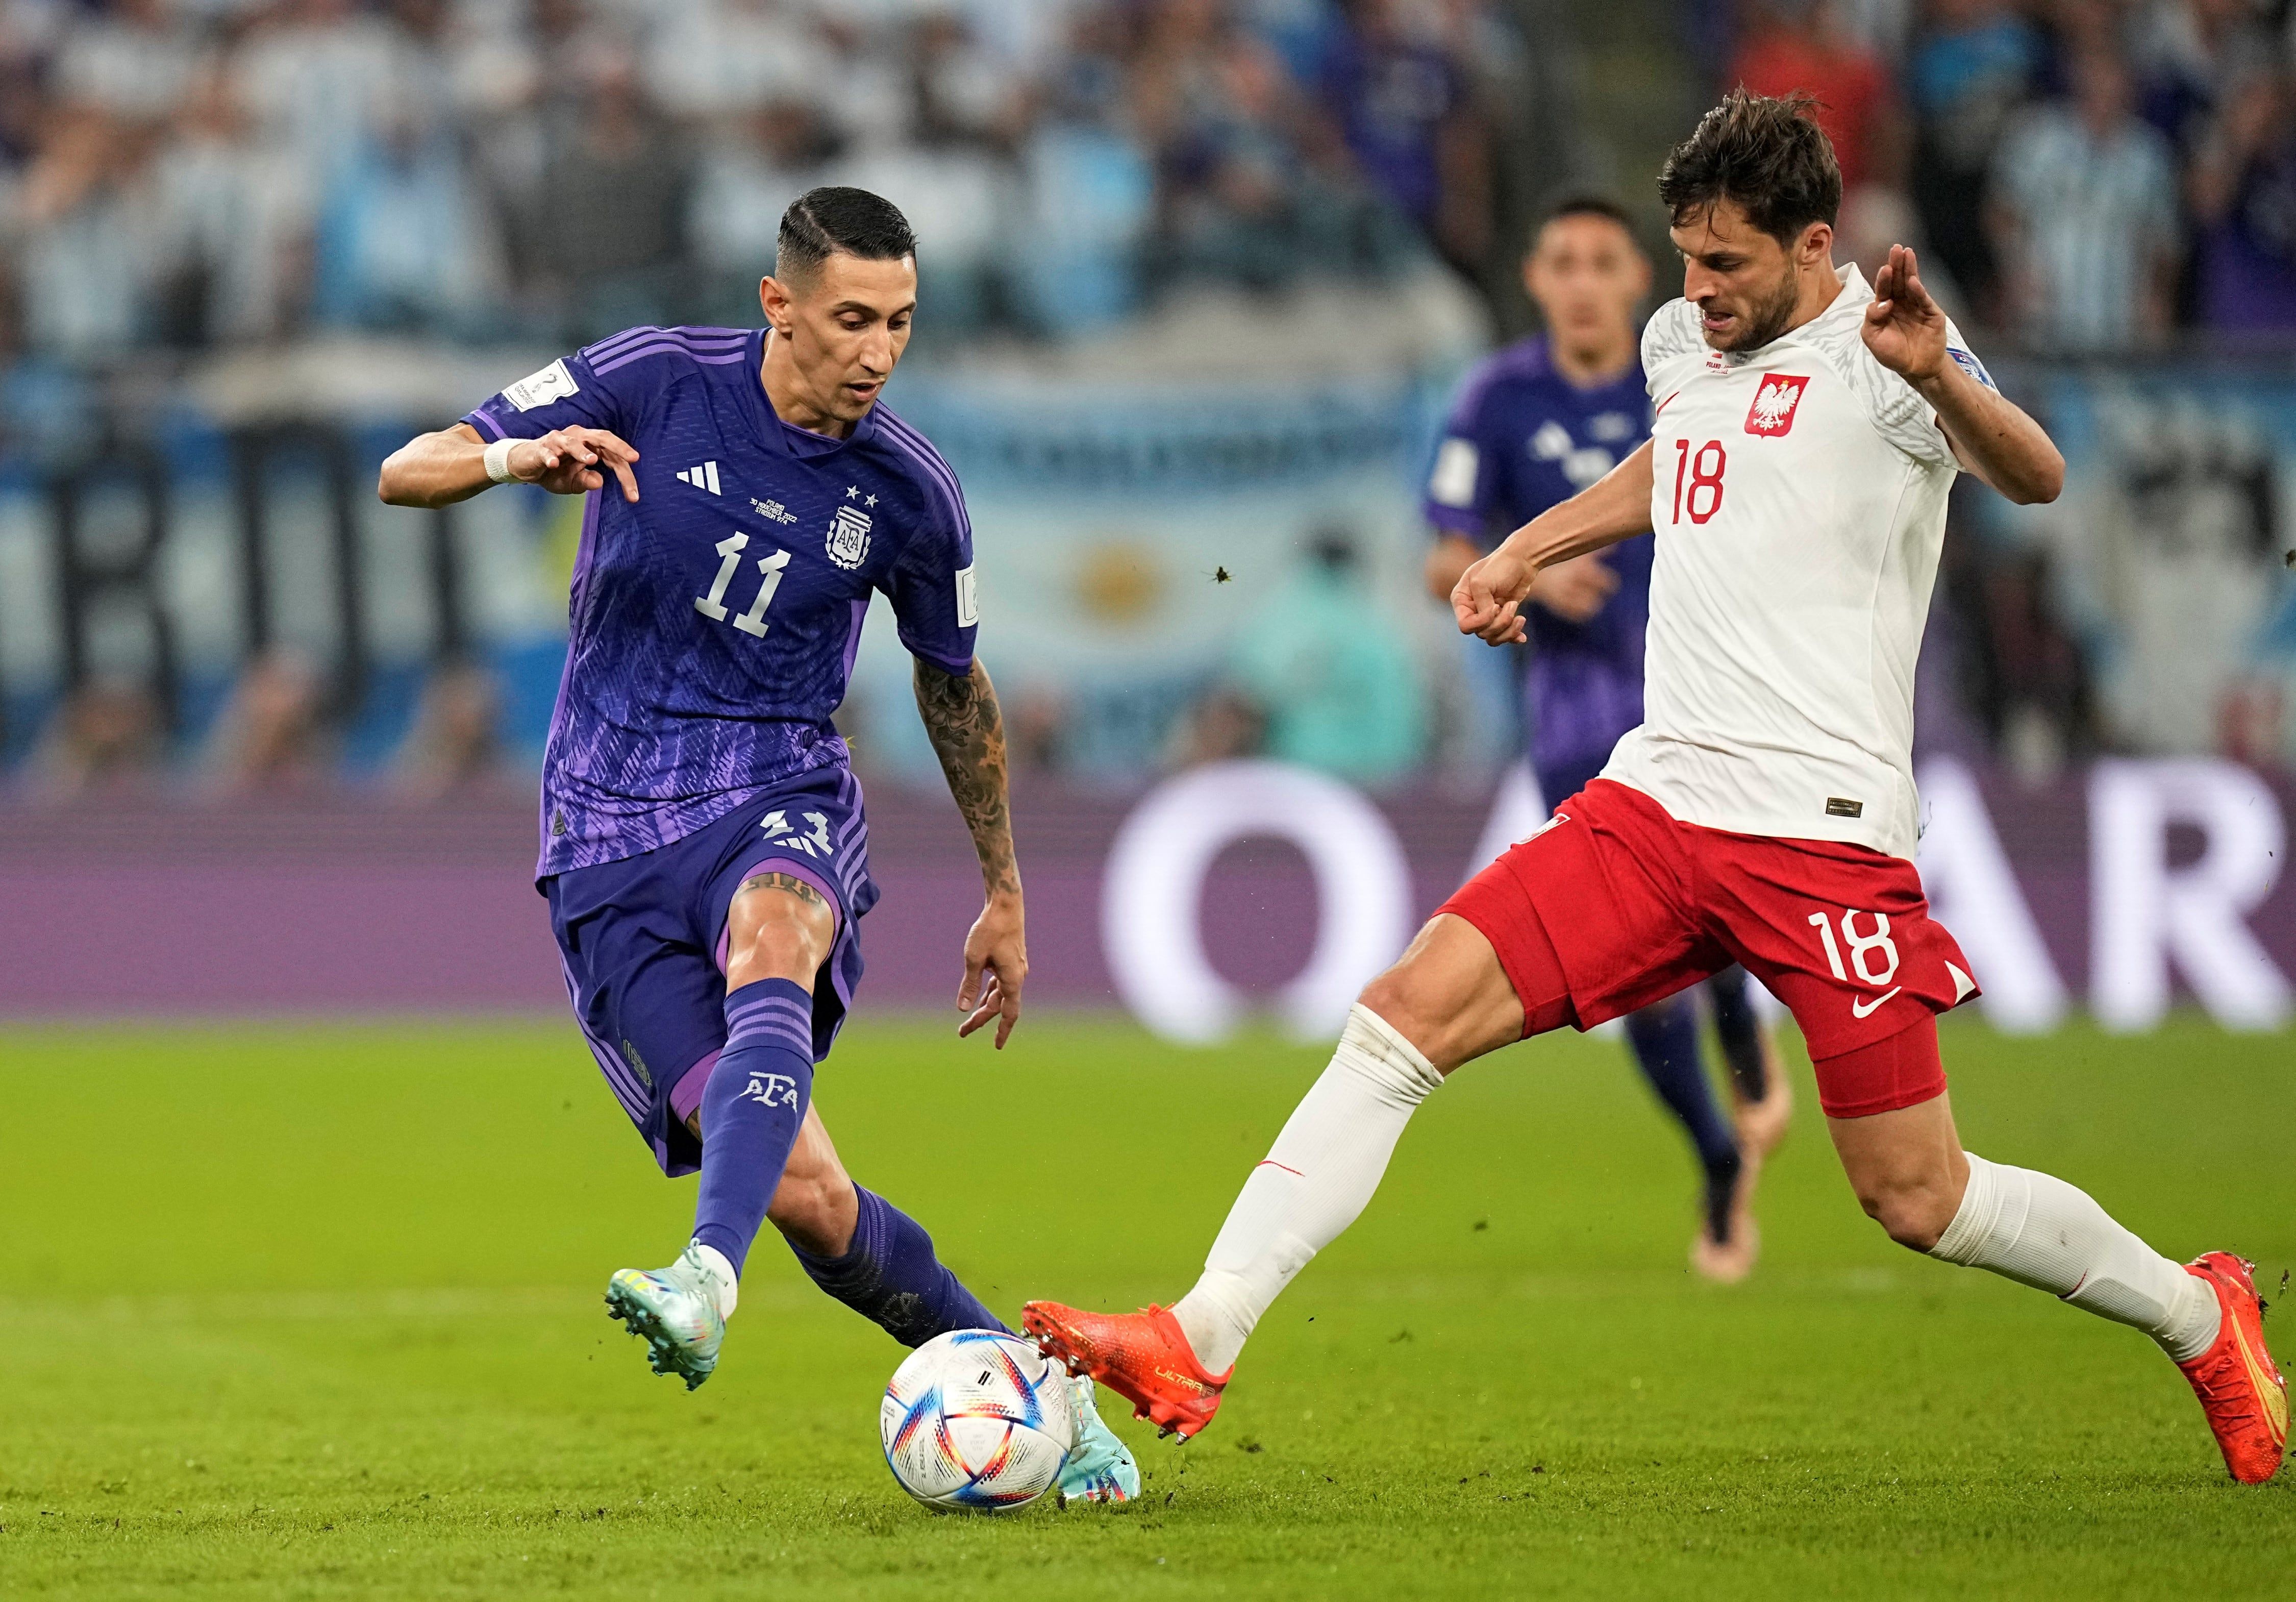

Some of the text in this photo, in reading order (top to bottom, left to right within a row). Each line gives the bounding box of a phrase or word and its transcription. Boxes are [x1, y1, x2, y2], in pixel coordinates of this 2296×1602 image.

[522, 389, 533, 400] WORLD
[1673, 439, 1727, 525] 18
[755, 506, 788, 525] STADIUM 974
[758, 501, 783, 516] NOVEMBER
[782, 512, 798, 523] 2022
[766, 499, 785, 511] POLAND
[837, 523, 859, 553] AFA
[693, 531, 791, 638] 11
[1808, 908, 1900, 985] 18
[739, 1071, 797, 1114] AFA
[1155, 1365, 1203, 1393] ULTRA
